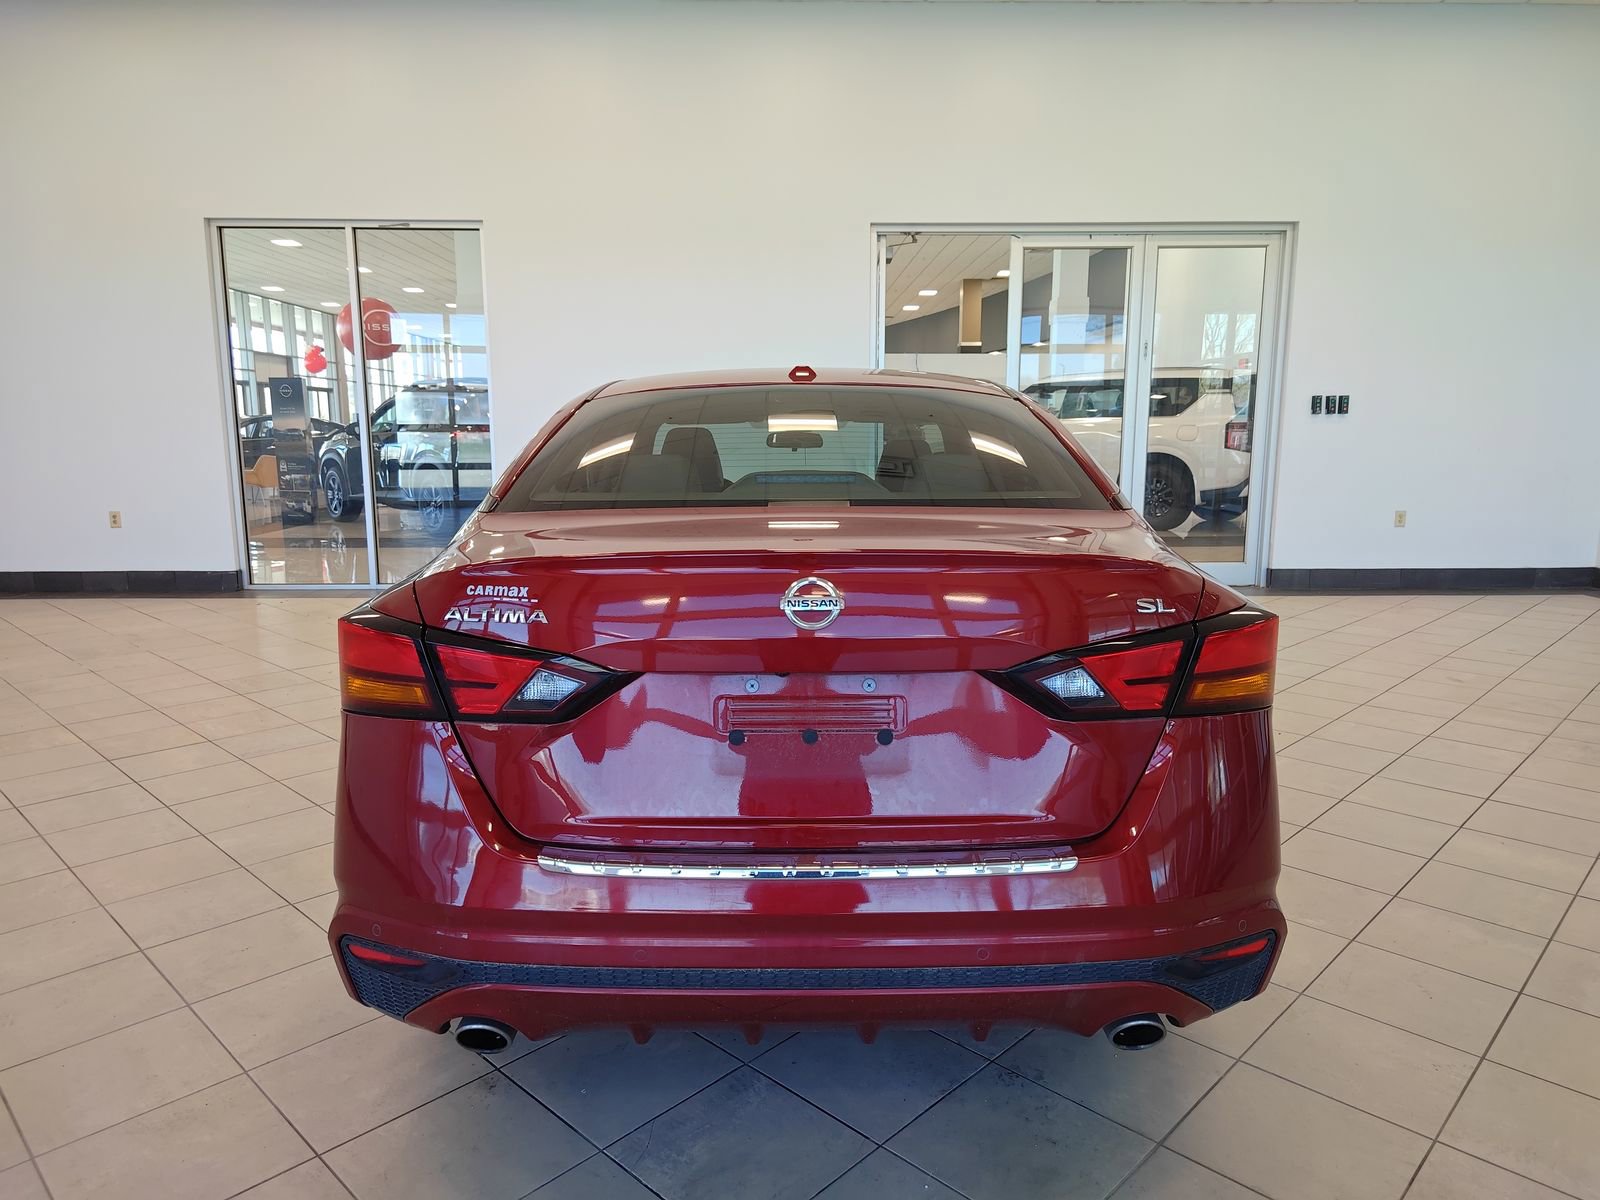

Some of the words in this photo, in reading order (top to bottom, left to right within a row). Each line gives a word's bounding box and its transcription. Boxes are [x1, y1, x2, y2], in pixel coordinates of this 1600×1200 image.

[787, 599, 838, 608] NISSAN
[1136, 598, 1176, 613] SL
[444, 607, 549, 624] ALTIMA
